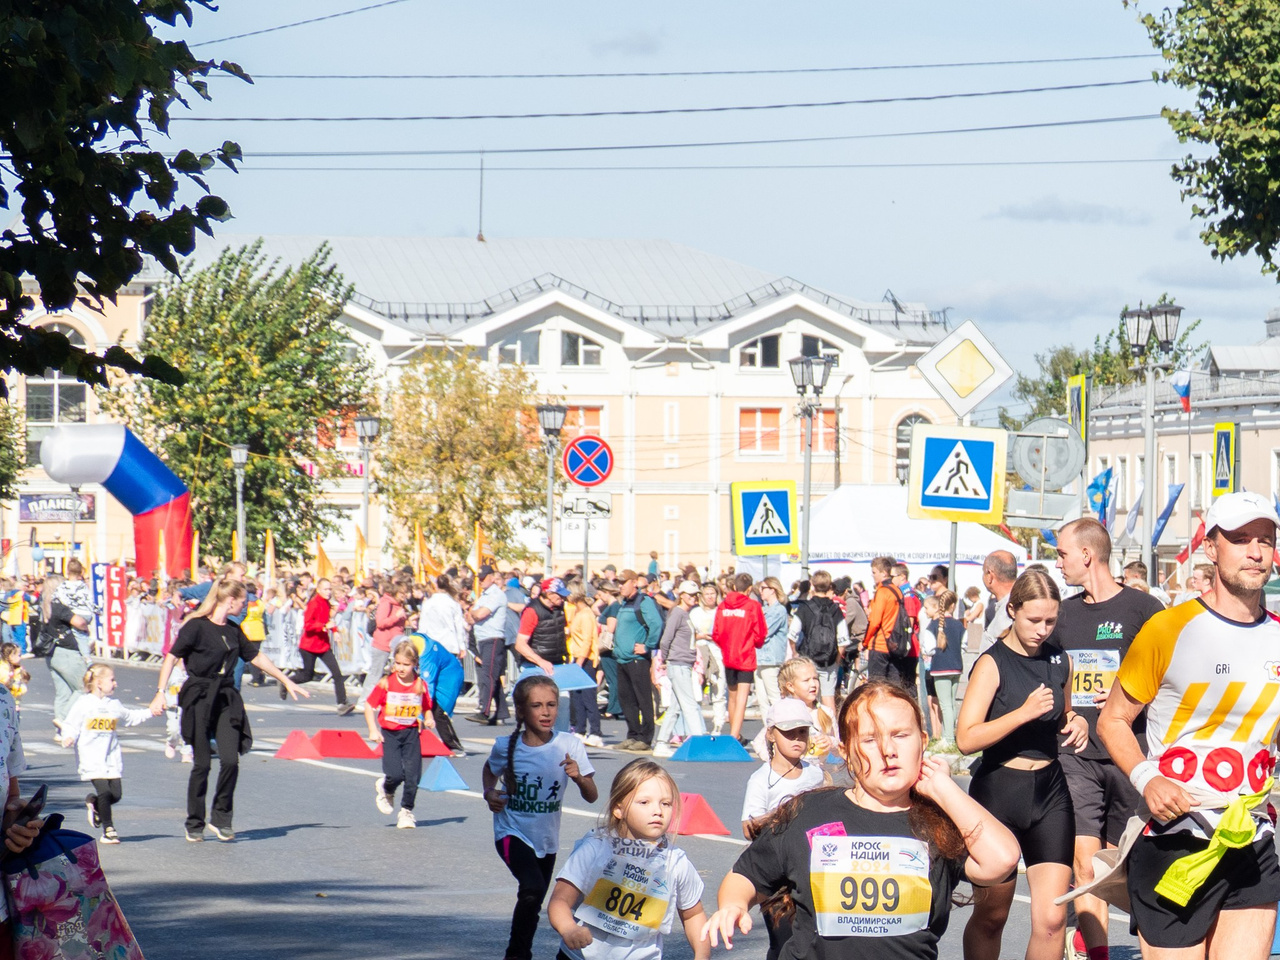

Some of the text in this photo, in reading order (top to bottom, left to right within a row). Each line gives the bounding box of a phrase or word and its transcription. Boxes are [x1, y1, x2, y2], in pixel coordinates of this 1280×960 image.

[110, 567, 122, 646] СТАРТ
[1074, 673, 1104, 692] 155
[394, 706, 417, 717] 1712
[851, 842, 881, 850] КРОСС
[850, 851, 890, 861] НАЦИИ
[625, 862, 646, 876] КРОСС
[851, 861, 891, 873] 2024
[623, 869, 649, 885] НАЦИИ
[840, 876, 900, 912] 999
[605, 887, 647, 921] 804
[837, 916, 902, 925] ВЛАДИМИРСКАЯ
[603, 921, 628, 936] ОБЛАСТЬ
[850, 925, 889, 934] ОБЛАСТЬ
